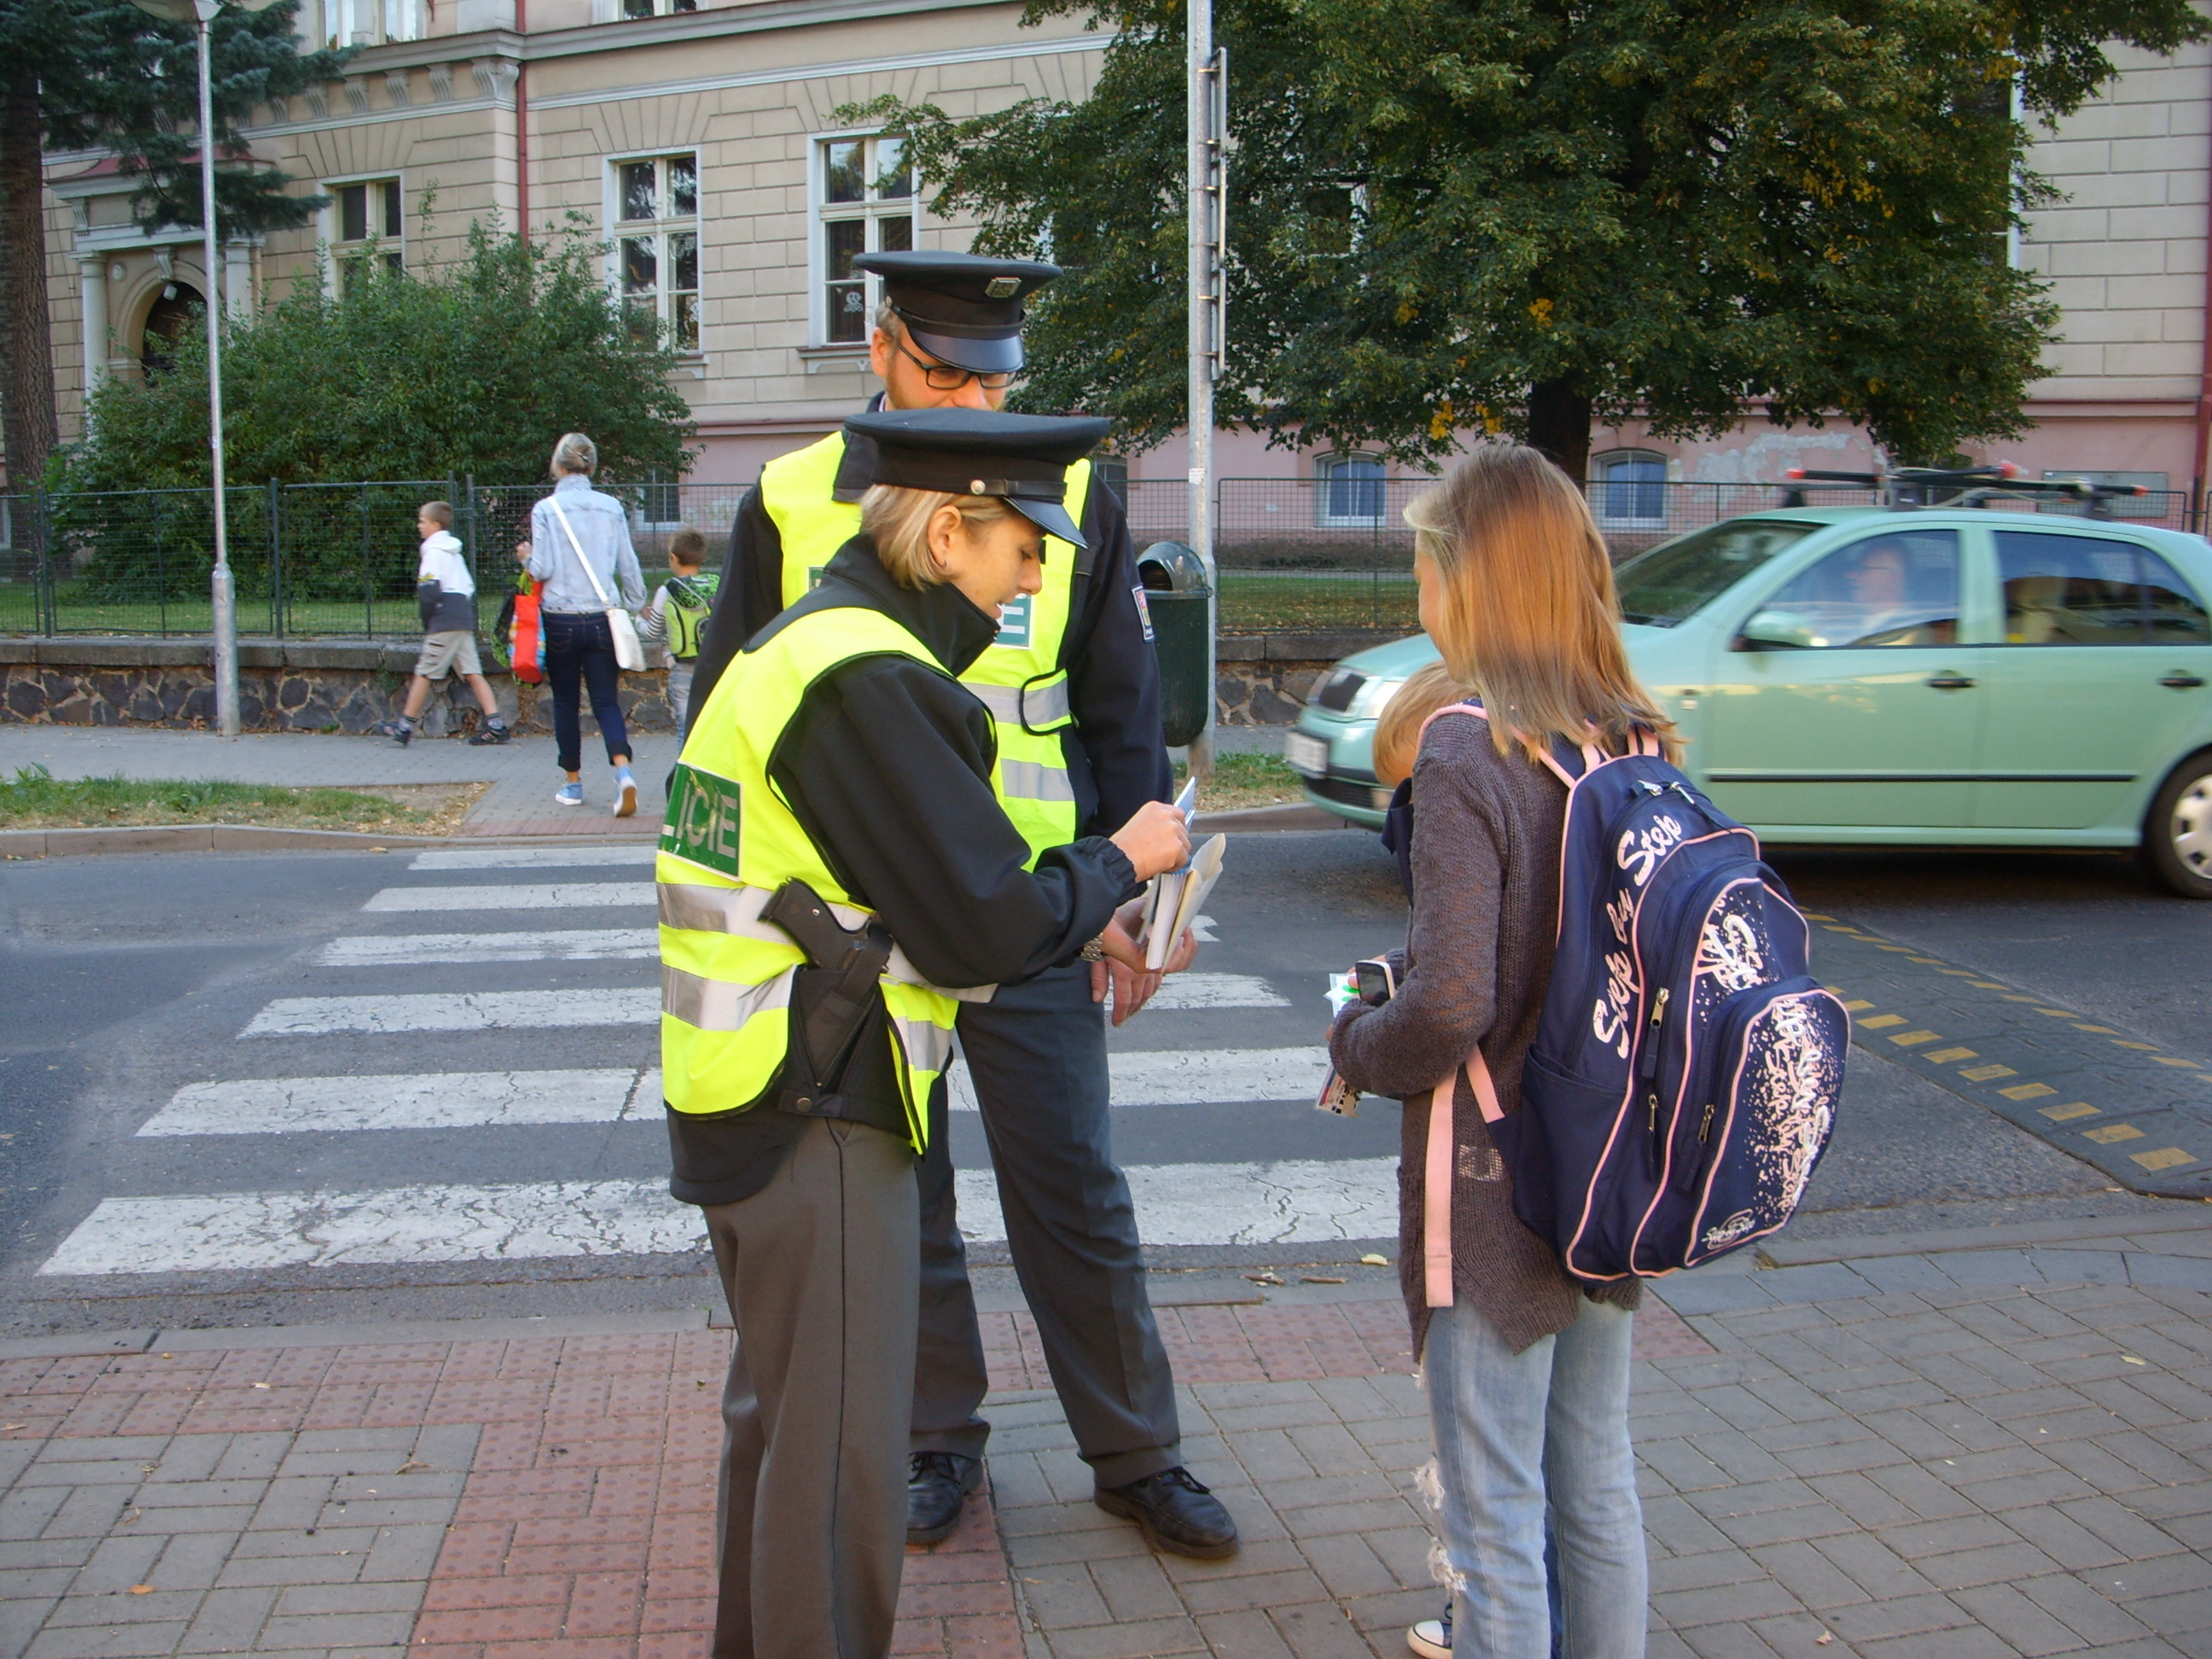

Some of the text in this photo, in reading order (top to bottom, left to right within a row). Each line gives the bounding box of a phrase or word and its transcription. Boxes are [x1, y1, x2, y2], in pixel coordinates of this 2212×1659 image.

[1593, 814, 1682, 1059] Step by Step
